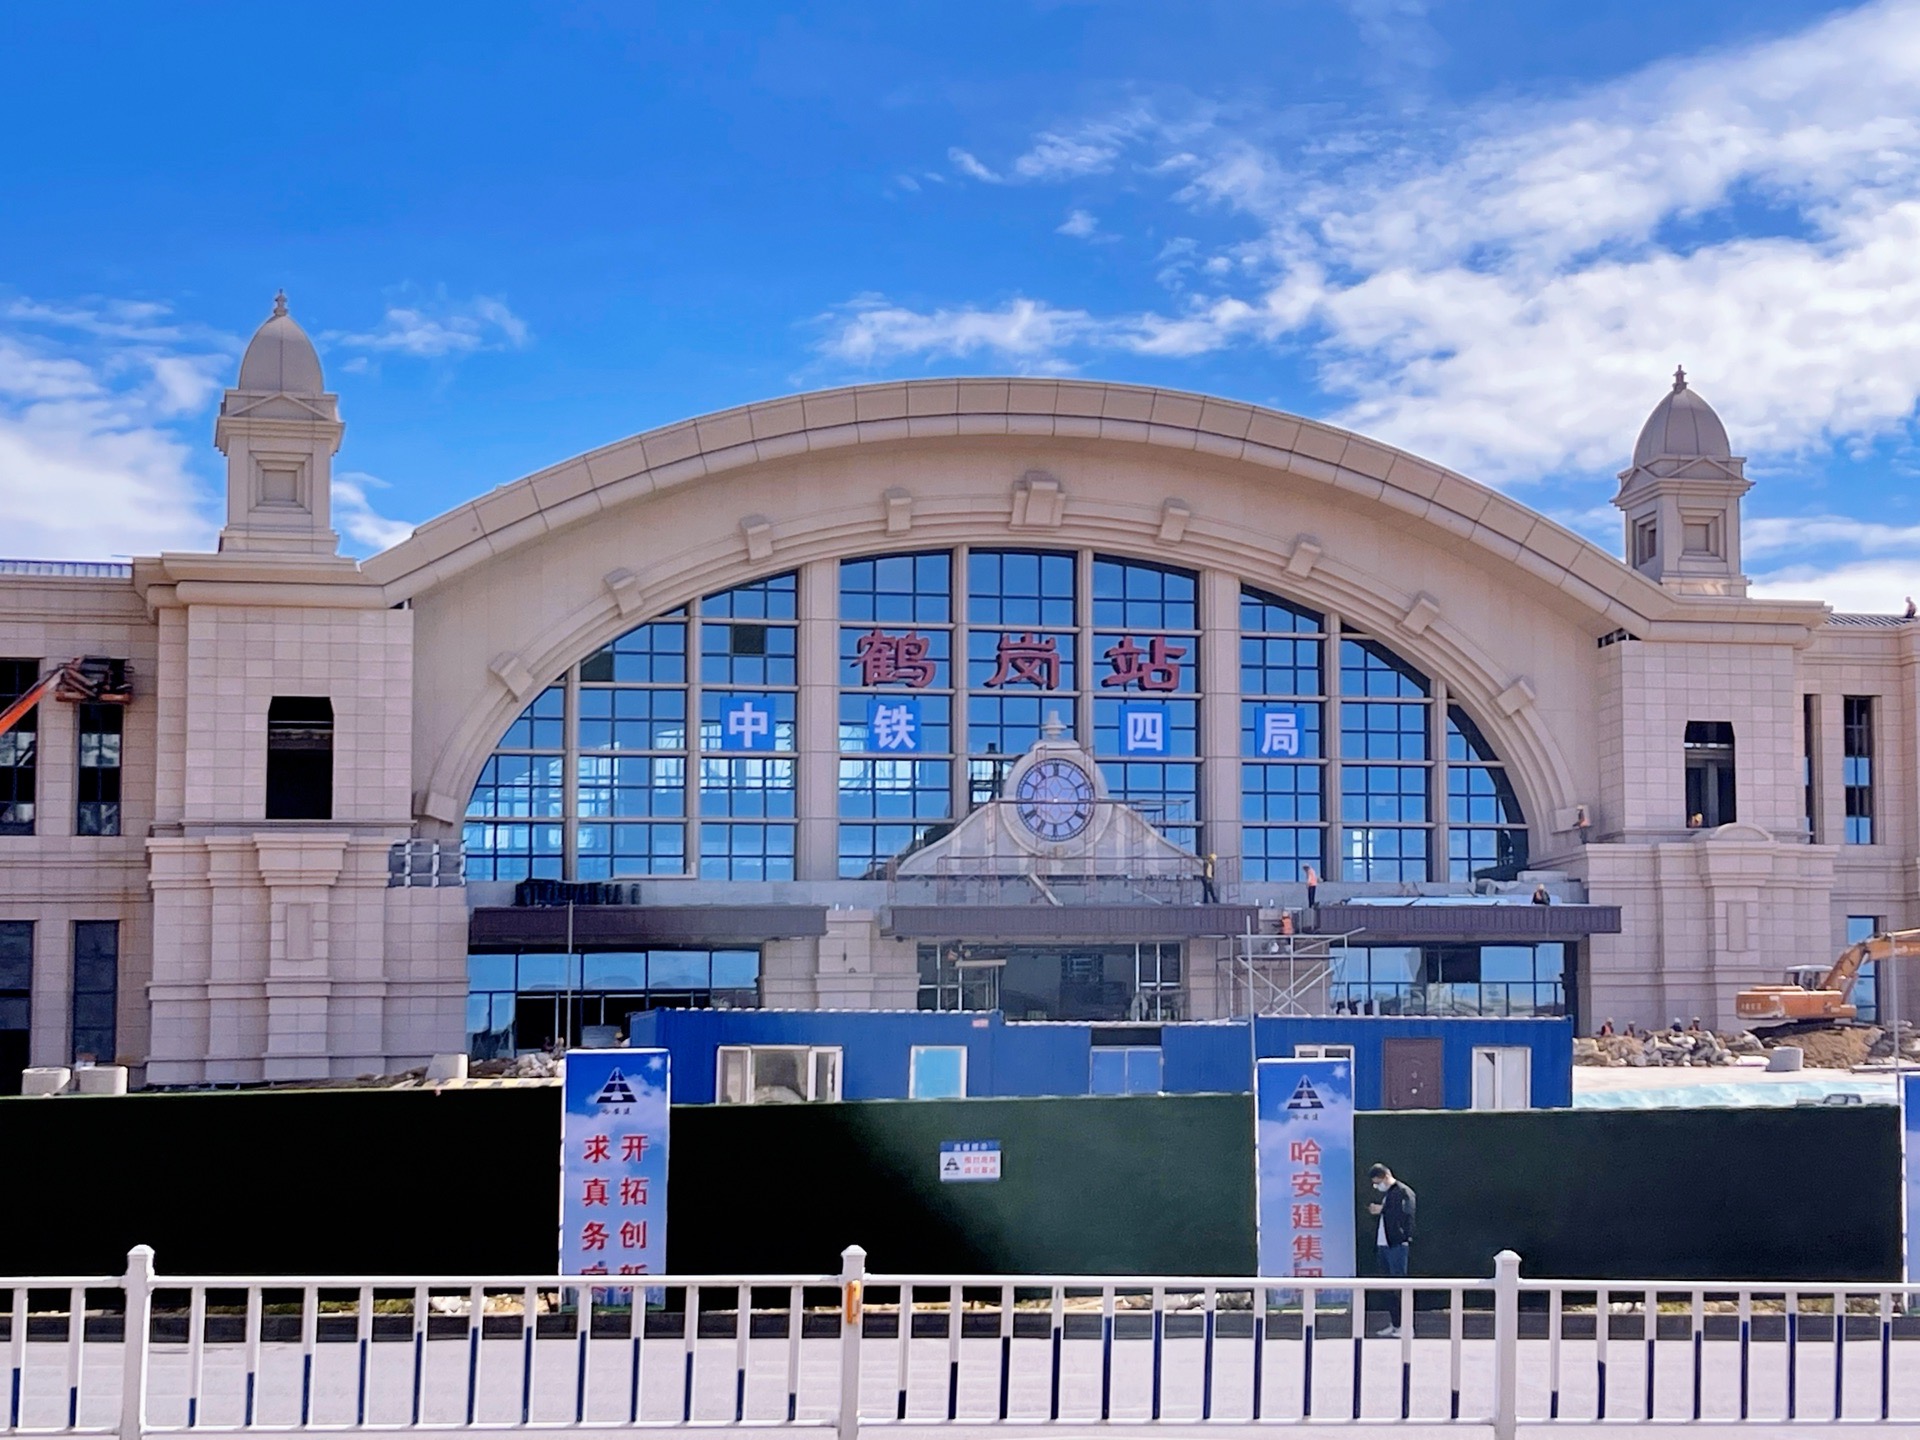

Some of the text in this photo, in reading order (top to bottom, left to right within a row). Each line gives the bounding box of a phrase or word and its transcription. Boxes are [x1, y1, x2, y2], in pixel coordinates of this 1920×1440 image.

[850, 629, 1187, 691] 鹤岗站
[728, 702, 1300, 756] 中铁四局
